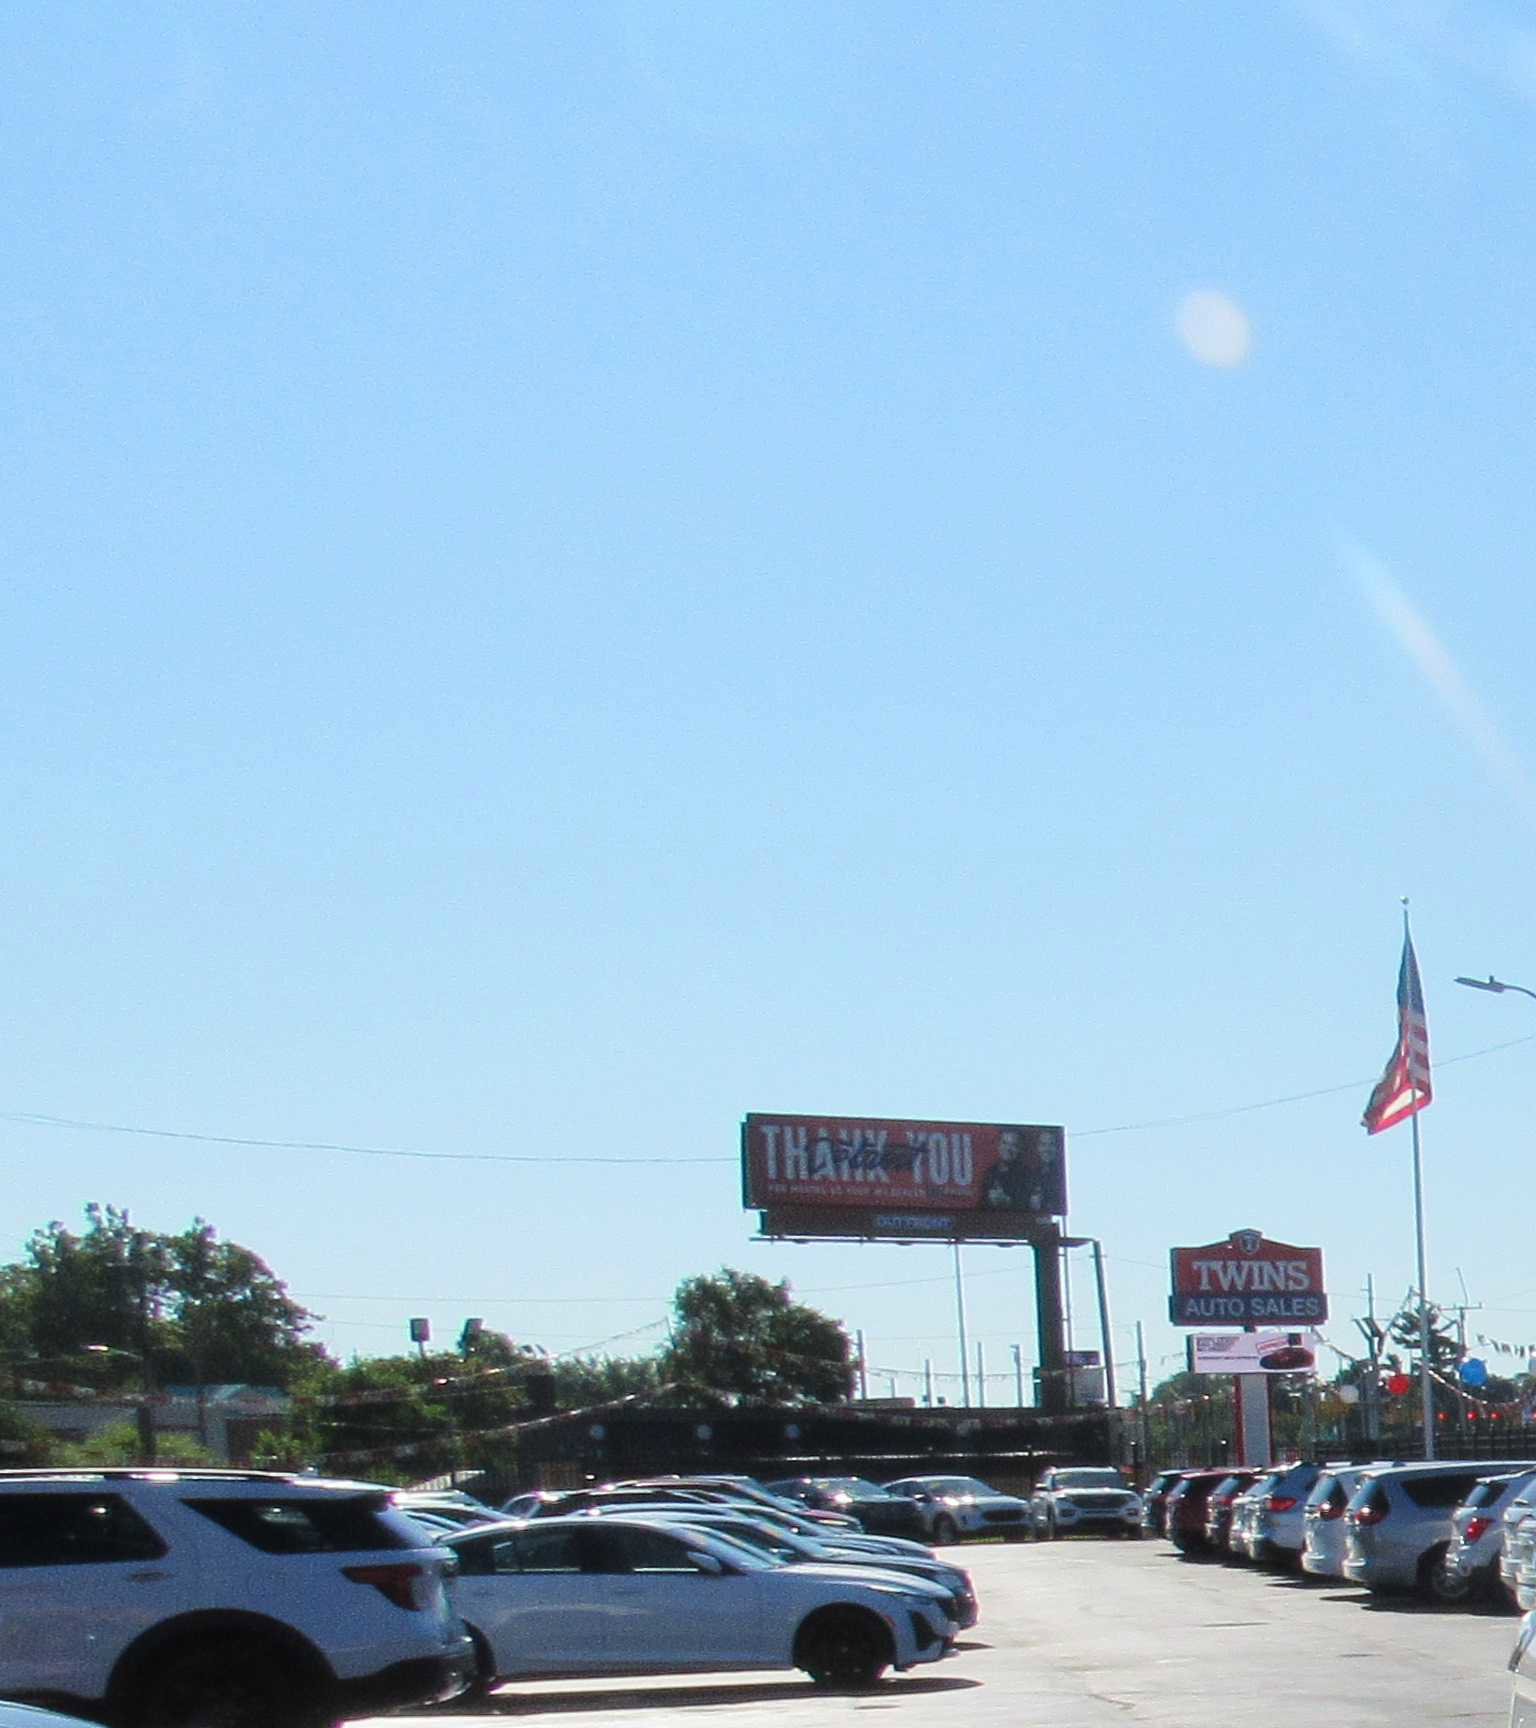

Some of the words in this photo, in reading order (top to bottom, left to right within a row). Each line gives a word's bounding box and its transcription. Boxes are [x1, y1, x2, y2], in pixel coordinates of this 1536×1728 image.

[761, 1125, 889, 1183] THANK
[907, 1130, 974, 1186] YOU
[1192, 1260, 1312, 1291] TWINS
[1186, 1298, 1245, 1316] AUTO
[1251, 1297, 1319, 1316] SALES
